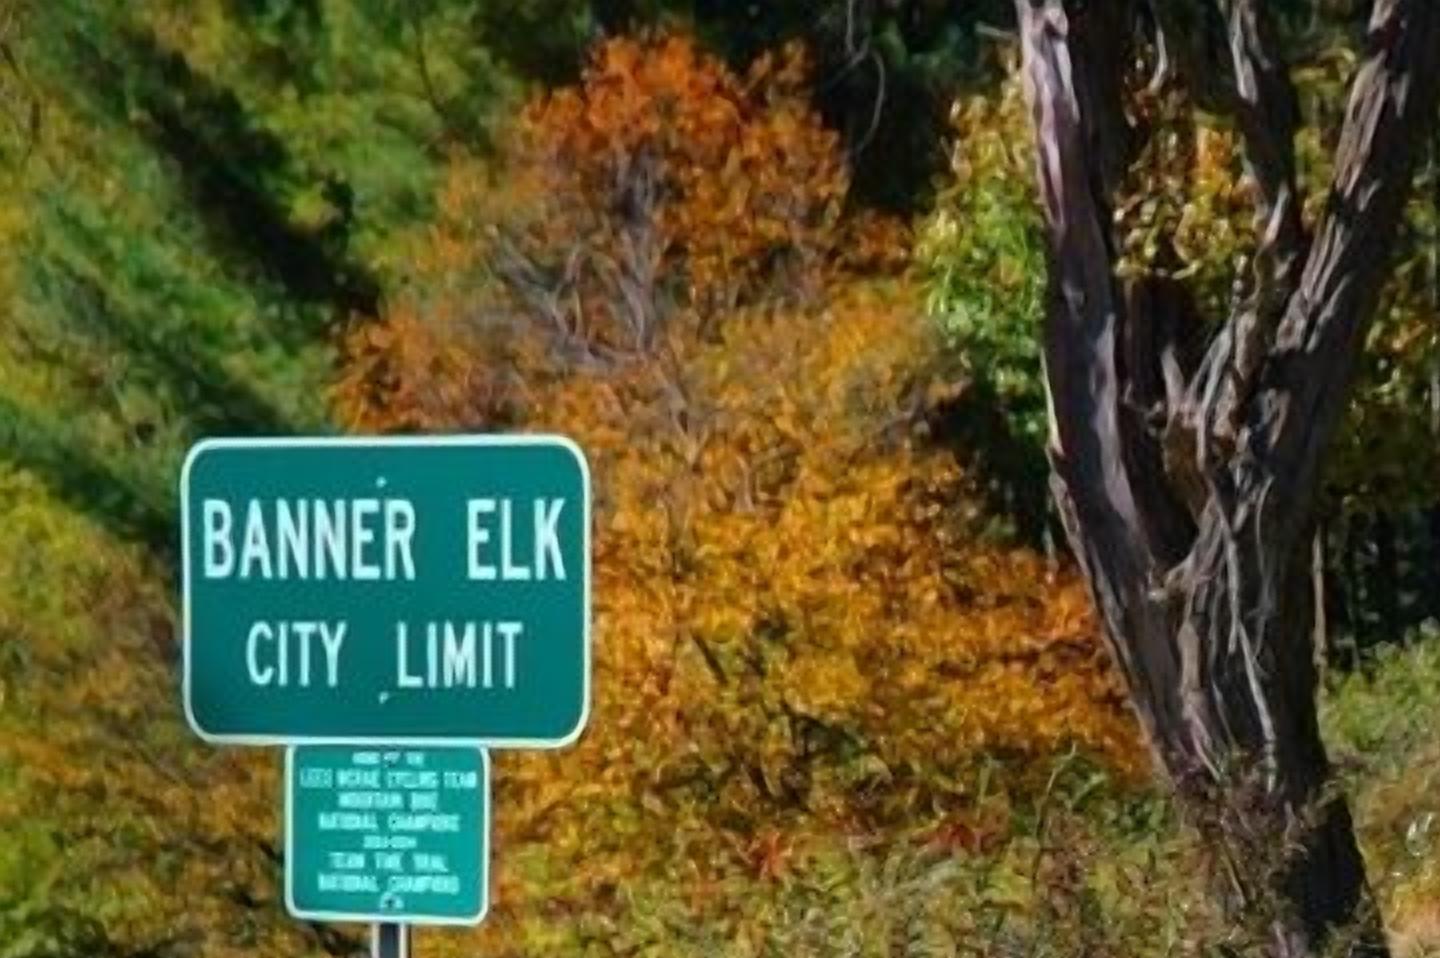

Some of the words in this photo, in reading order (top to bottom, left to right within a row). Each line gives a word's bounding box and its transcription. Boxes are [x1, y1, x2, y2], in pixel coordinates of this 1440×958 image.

[203, 498, 416, 580] BANNER
[466, 498, 566, 580] ELK
[246, 621, 346, 688] CITY
[397, 620, 523, 688] LIMIT
